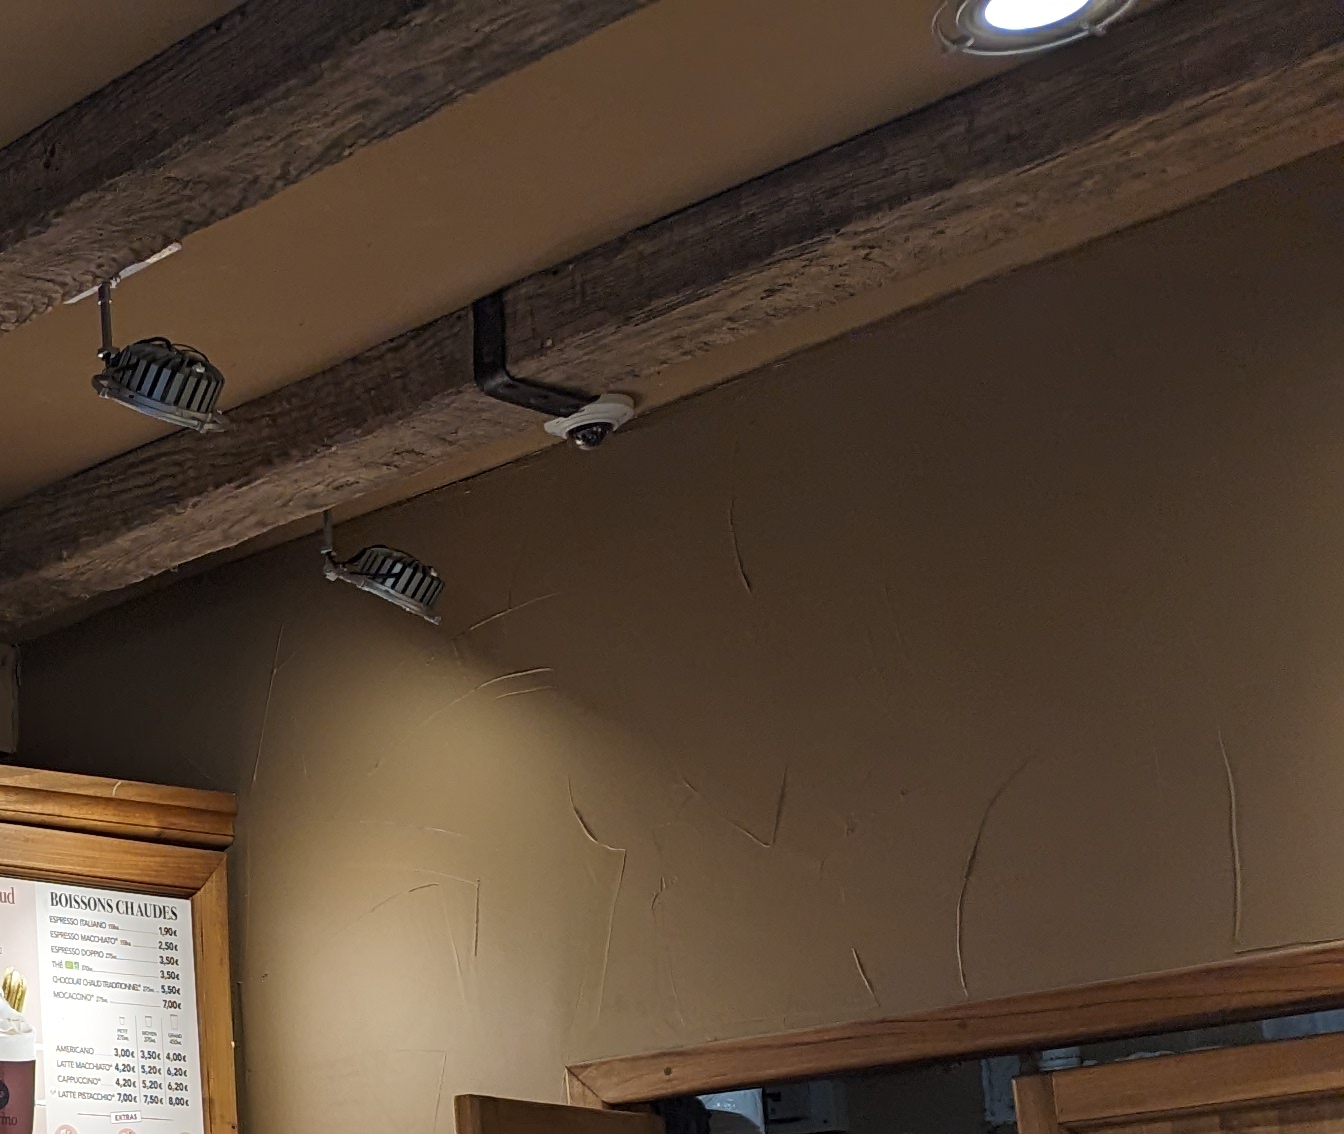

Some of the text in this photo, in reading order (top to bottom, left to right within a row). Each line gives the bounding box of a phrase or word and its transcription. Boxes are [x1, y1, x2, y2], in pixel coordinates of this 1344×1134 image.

[50, 891, 178, 921] BOISSONS CHAUDES
[114, 1113, 138, 1121] EXTRAS
